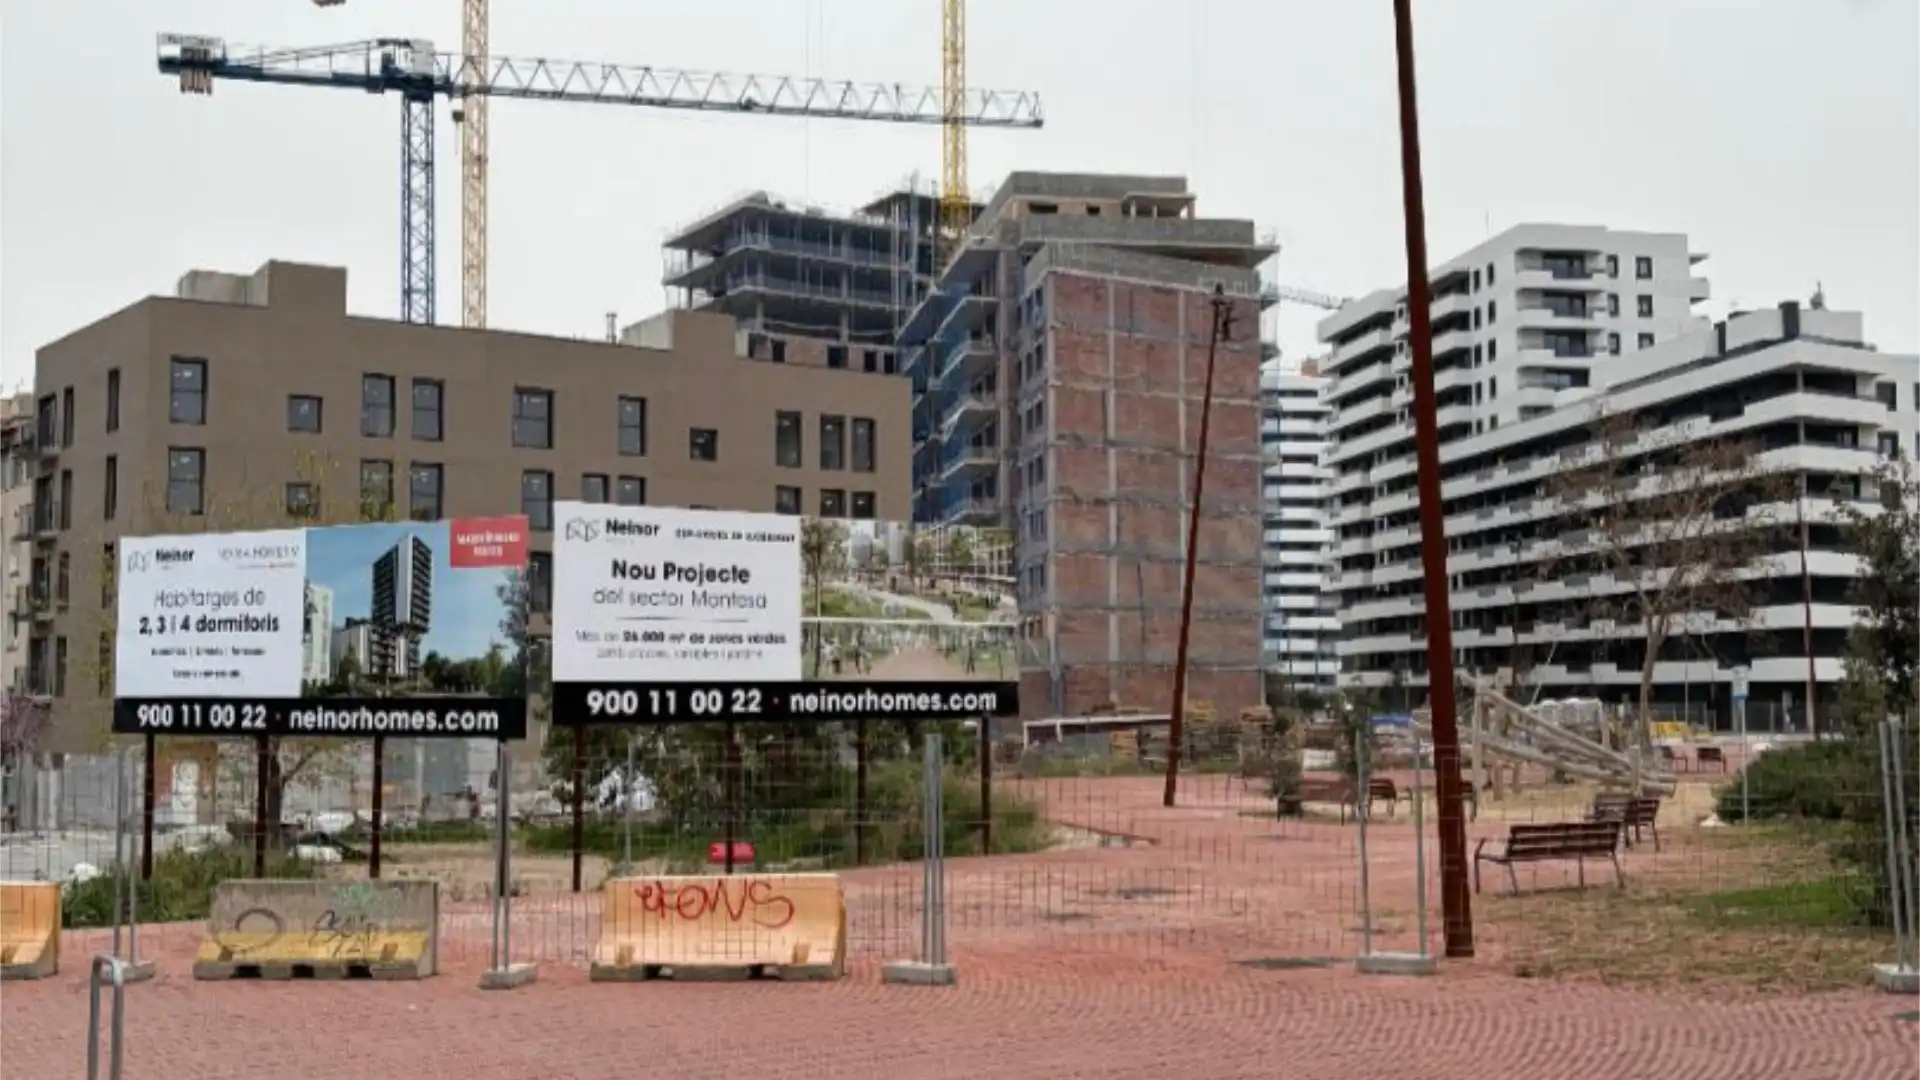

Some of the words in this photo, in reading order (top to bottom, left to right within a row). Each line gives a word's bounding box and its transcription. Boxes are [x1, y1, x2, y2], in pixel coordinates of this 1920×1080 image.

[605, 518, 661, 538] Neinor
[156, 547, 195, 563] Neinor
[611, 558, 656, 581] Nou
[662, 560, 752, 587] Projecte
[244, 587, 267, 606] de
[629, 588, 684, 608] sector
[691, 588, 769, 610] Montesa
[156, 615, 167, 634] 3
[180, 614, 191, 632] 4
[195, 612, 280, 633] dormitoris
[689, 631, 705, 644] de
[587, 689, 639, 715] 900
[649, 689, 677, 715] 11
[690, 689, 724, 714] 00
[731, 688, 762, 714] 22
[790, 688, 997, 713] neinorhomes.com
[136, 703, 174, 728] 900
[181, 703, 202, 727] 11
[209, 704, 236, 728] 00
[241, 703, 268, 729] 22
[289, 704, 499, 730] neinorhomes.com
